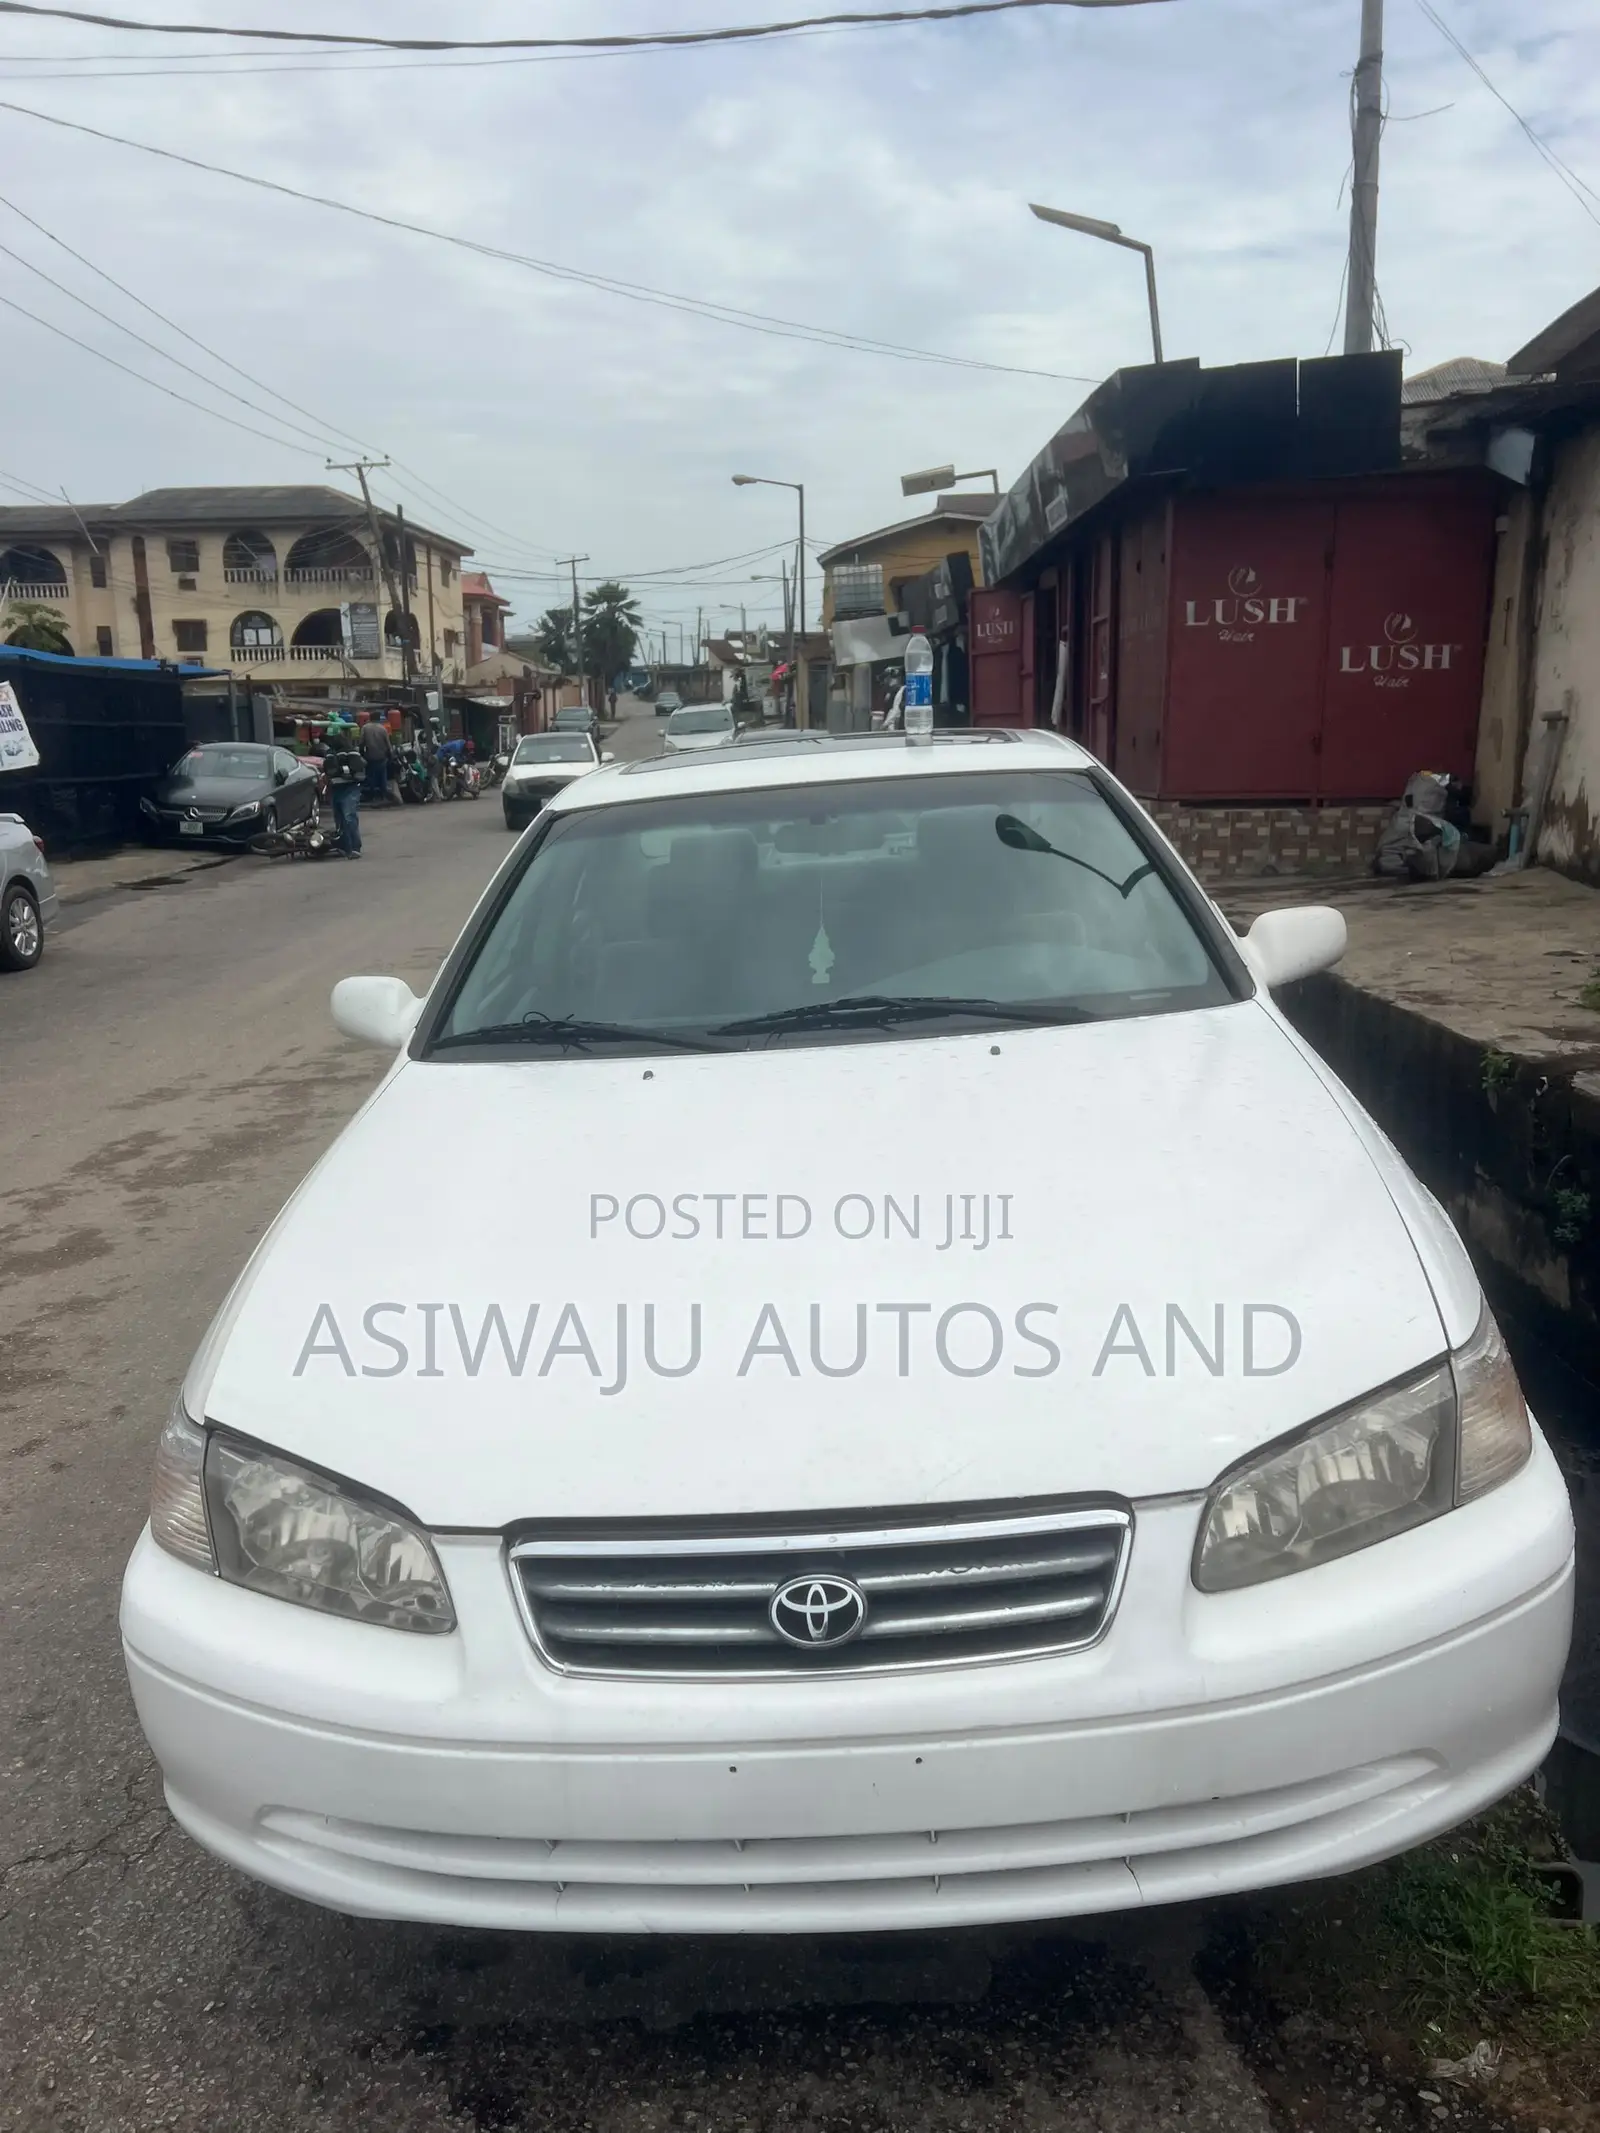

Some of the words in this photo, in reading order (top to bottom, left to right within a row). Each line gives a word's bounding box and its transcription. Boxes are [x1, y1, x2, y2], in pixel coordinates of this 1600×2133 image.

[1184, 597, 1299, 626] LUSH
[1340, 643, 1452, 672] LUSH
[0, 704, 14, 718] SH
